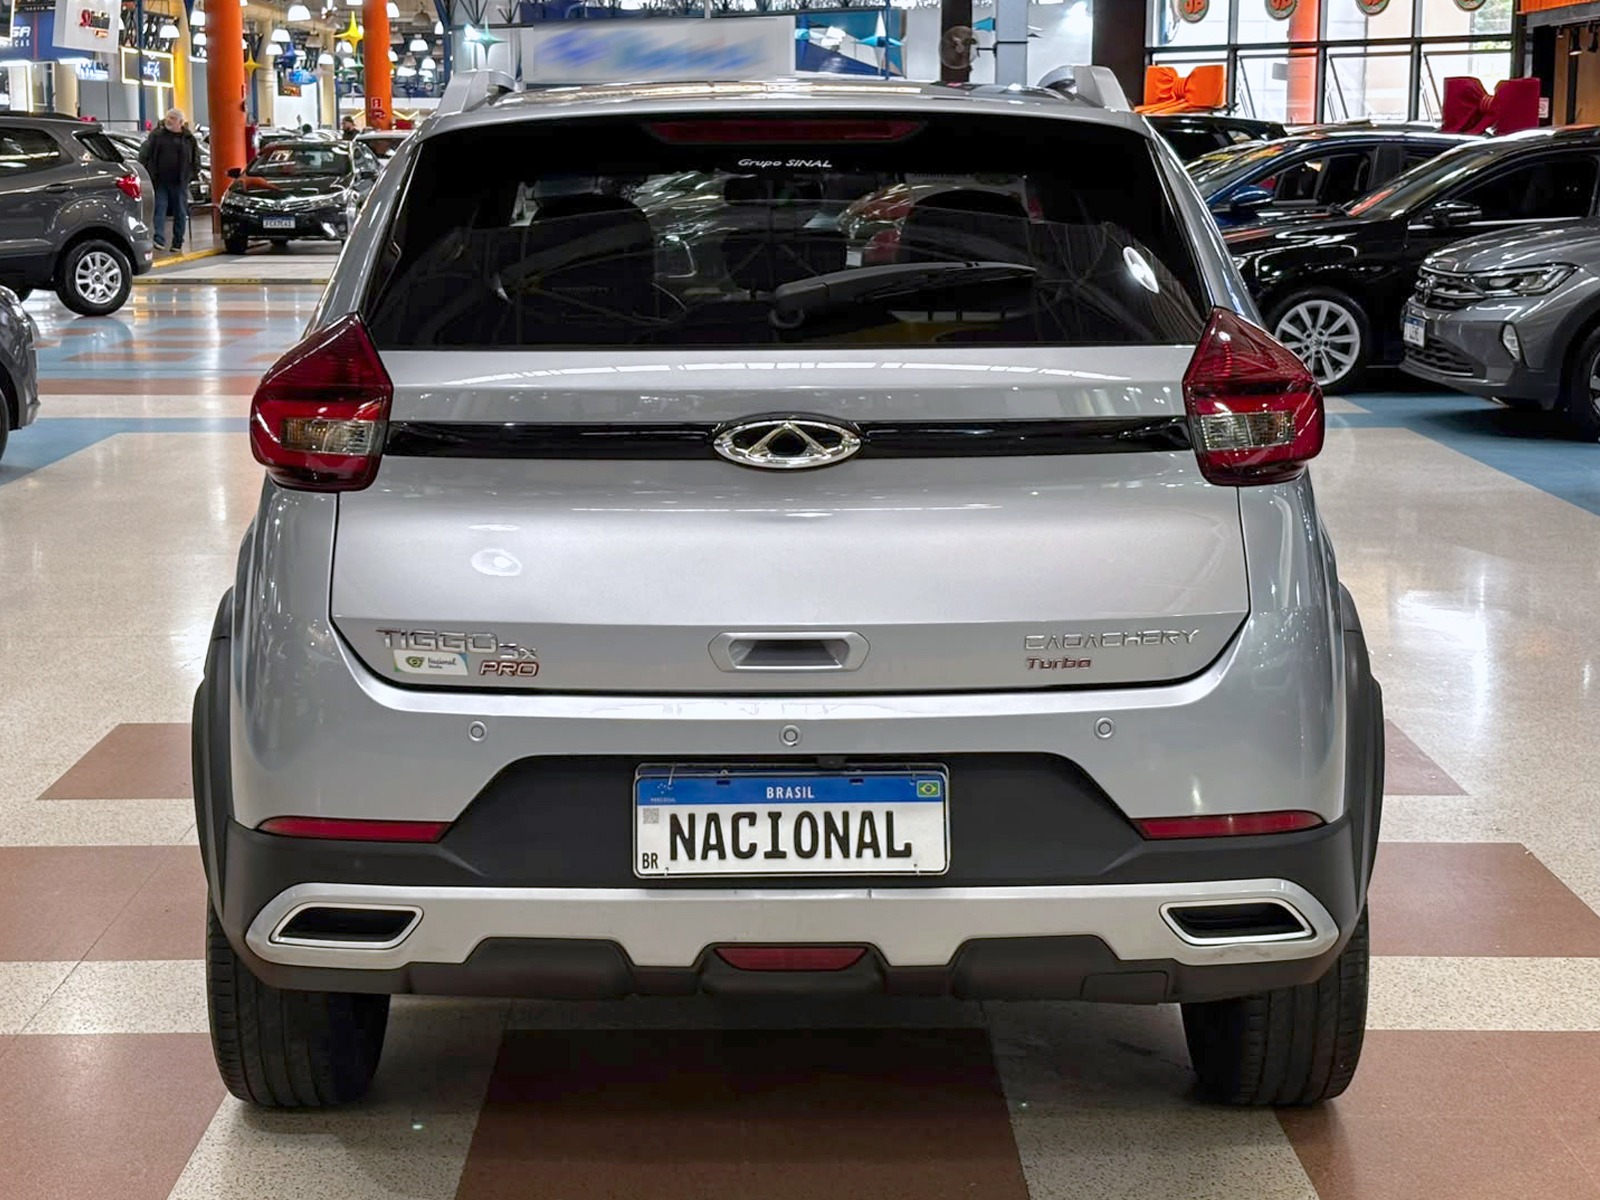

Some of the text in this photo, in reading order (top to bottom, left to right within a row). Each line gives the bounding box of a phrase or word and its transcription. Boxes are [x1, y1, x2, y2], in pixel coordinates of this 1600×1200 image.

[738, 158, 832, 168] Grupo SINAL
[376, 627, 498, 653] TIGGO
[480, 660, 539, 677] PRO
[1026, 655, 1092, 670] Turbo
[766, 786, 815, 799] BRASIL
[669, 810, 912, 861] NACIONAL
[642, 853, 659, 869] BR
